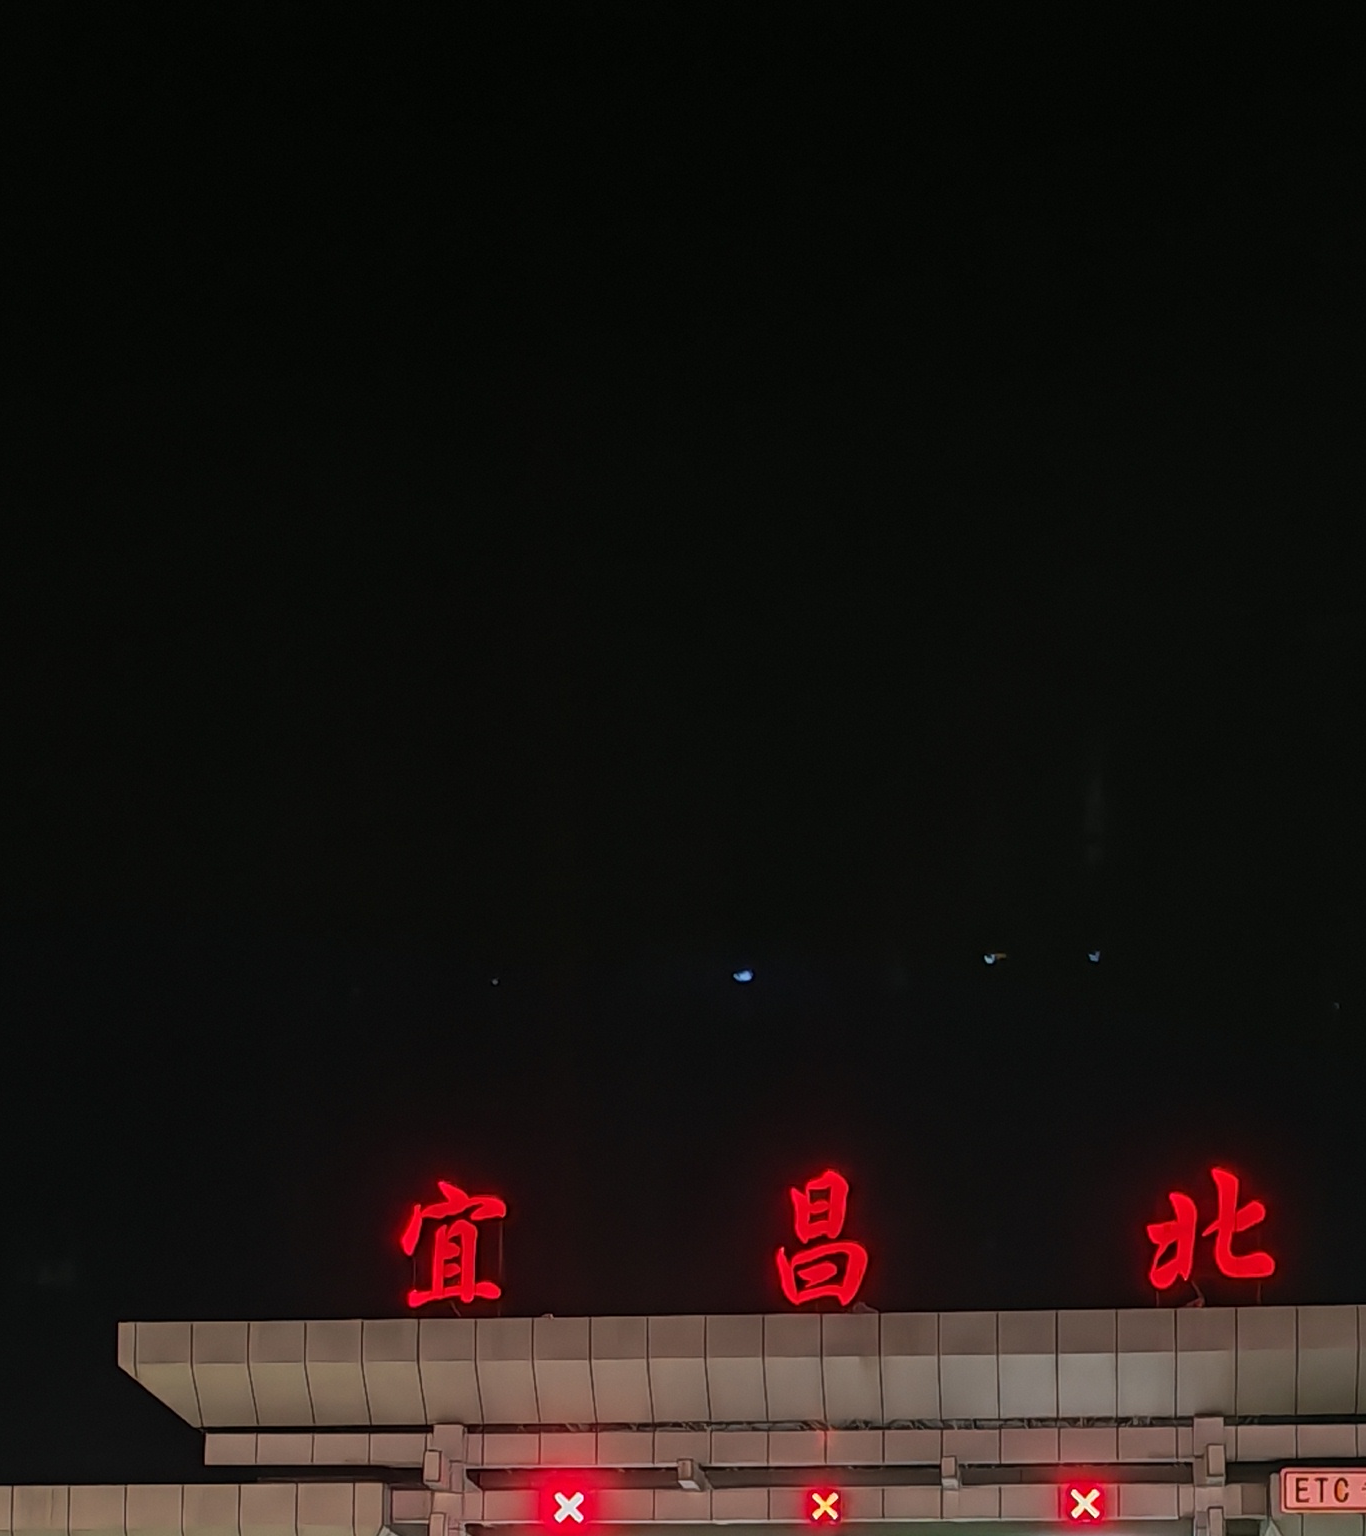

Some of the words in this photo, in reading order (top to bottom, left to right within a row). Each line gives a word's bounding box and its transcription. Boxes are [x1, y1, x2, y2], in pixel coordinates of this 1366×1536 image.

[401, 1168, 1277, 1308] 宜昌北
[1294, 1477, 1350, 1504] ETC
